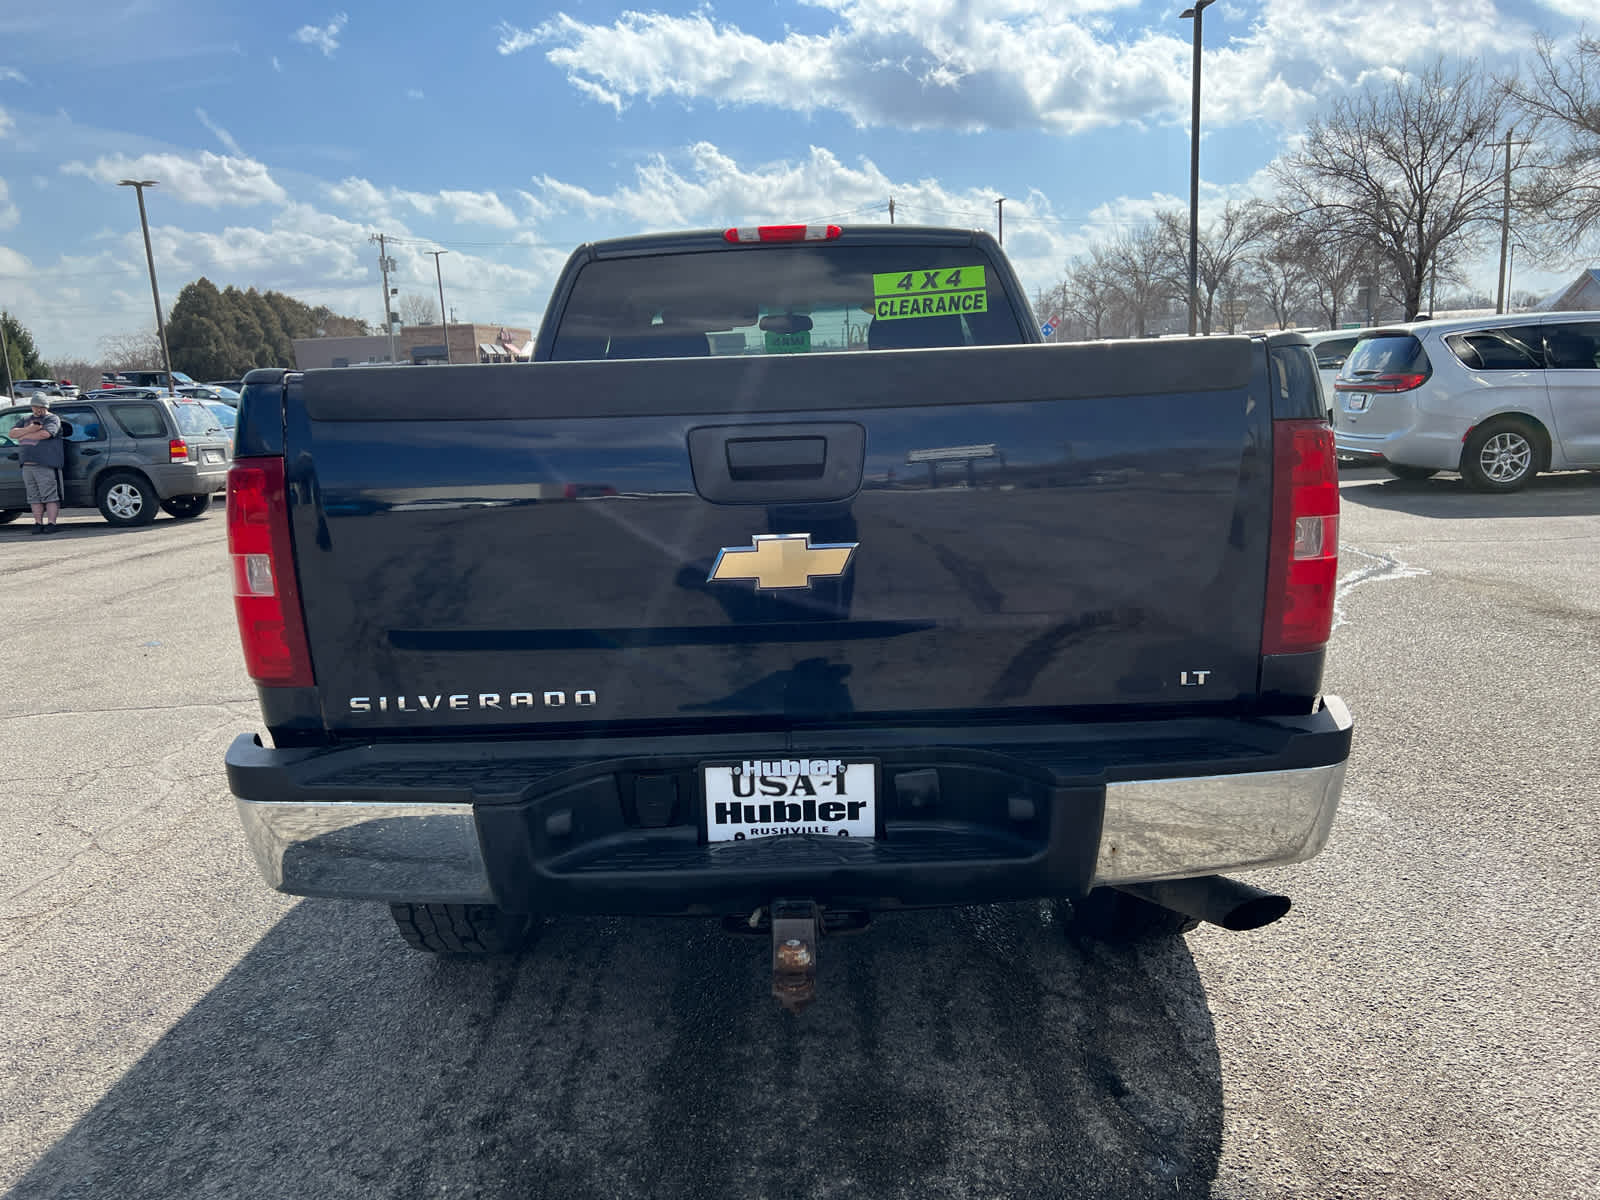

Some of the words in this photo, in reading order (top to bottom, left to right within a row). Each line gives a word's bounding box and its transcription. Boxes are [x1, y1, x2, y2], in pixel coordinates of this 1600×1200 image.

[877, 293, 985, 317] CLEARANCE
[1180, 671, 1211, 686] LT
[349, 689, 597, 713] SILVERADO
[742, 759, 842, 777] Hubler
[715, 800, 867, 824] Hubler
[750, 825, 829, 836] RUSHVILLE
